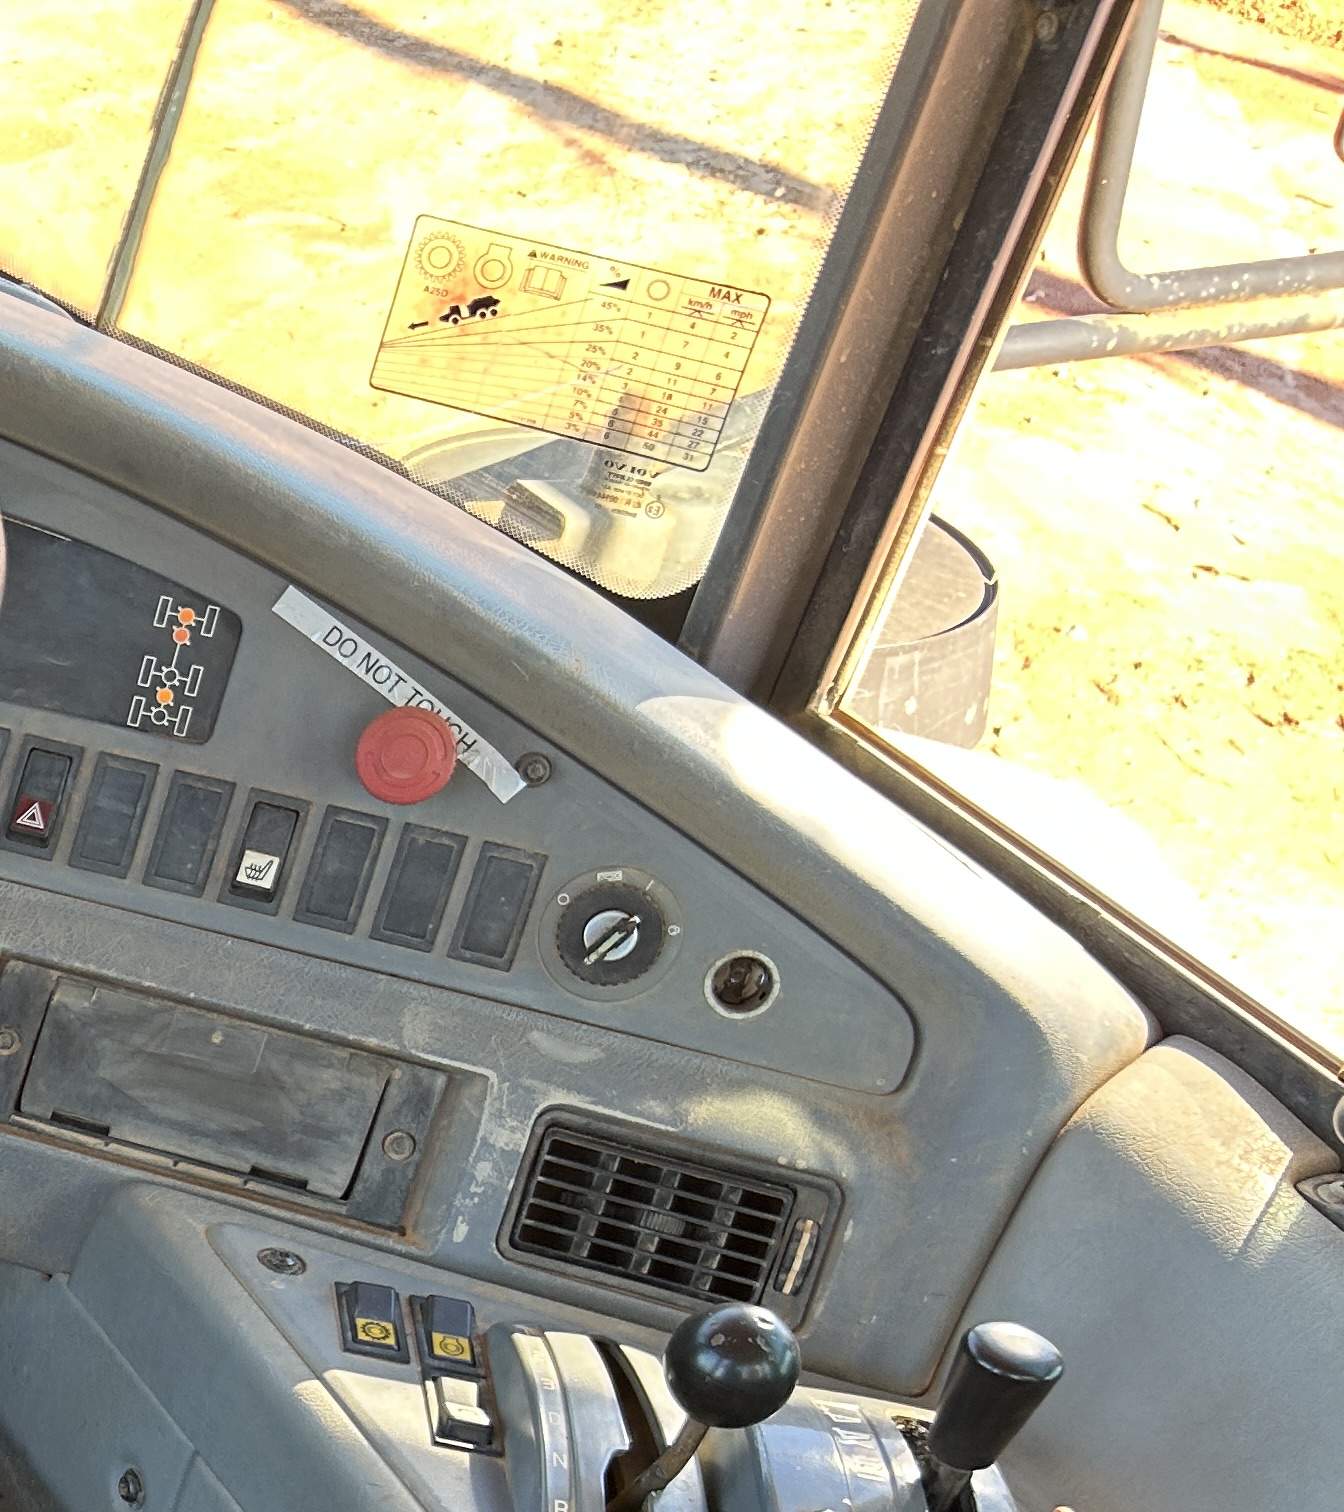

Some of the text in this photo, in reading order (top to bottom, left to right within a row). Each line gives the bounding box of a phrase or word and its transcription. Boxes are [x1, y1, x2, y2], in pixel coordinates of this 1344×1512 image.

[539, 250, 590, 270] WARNING
[423, 285, 449, 298] A25D
[709, 286, 744, 305] MAX
[687, 298, 753, 320] km/h mph
[592, 323, 730, 359] 35% 1 7 4
[647, 311, 653, 319] 1
[689, 322, 697, 330] 4
[730, 331, 738, 340] 2
[580, 360, 717, 396] 20% 2 11 7
[585, 344, 722, 381] 25% 2 9 6
[573, 386, 592, 398] 10%
[656, 406, 668, 416] 24
[697, 416, 709, 425] 15
[577, 373, 713, 411] 14% 3 18 11
[573, 399, 588, 410] 7%
[691, 428, 704, 438] 22
[564, 422, 580, 432] 3%
[682, 452, 694, 461] 31
[687, 440, 700, 449] 27
[322, 625, 358, 658] DO
[356, 652, 407, 693] NOT
[548, 1411, 562, 1426] D
[553, 1452, 568, 1469] N
